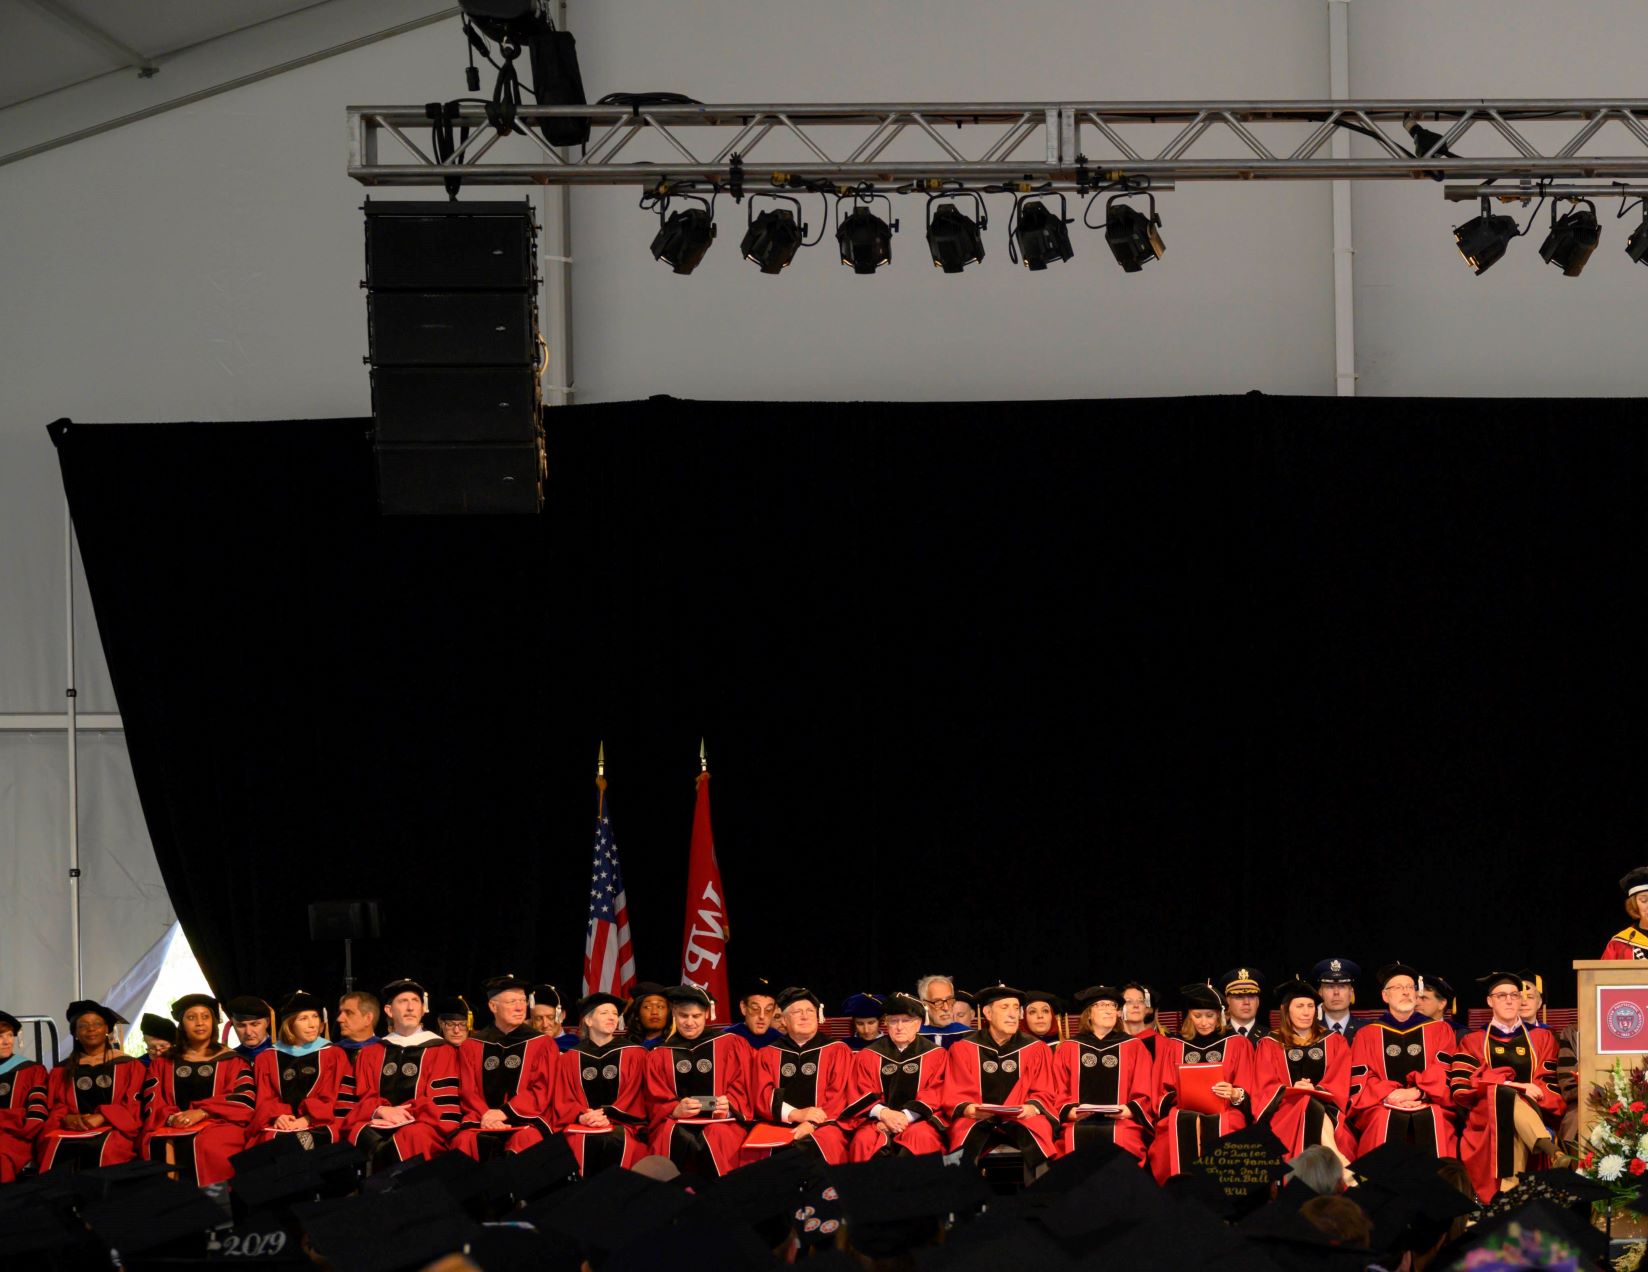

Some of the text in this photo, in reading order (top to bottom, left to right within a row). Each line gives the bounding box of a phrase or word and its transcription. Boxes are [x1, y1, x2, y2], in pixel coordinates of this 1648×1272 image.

[1223, 1142, 1264, 1150] Sooner
[1192, 1156, 1215, 1166] All
[1217, 1157, 1241, 1166] Our
[223, 1230, 287, 1256] 2019
